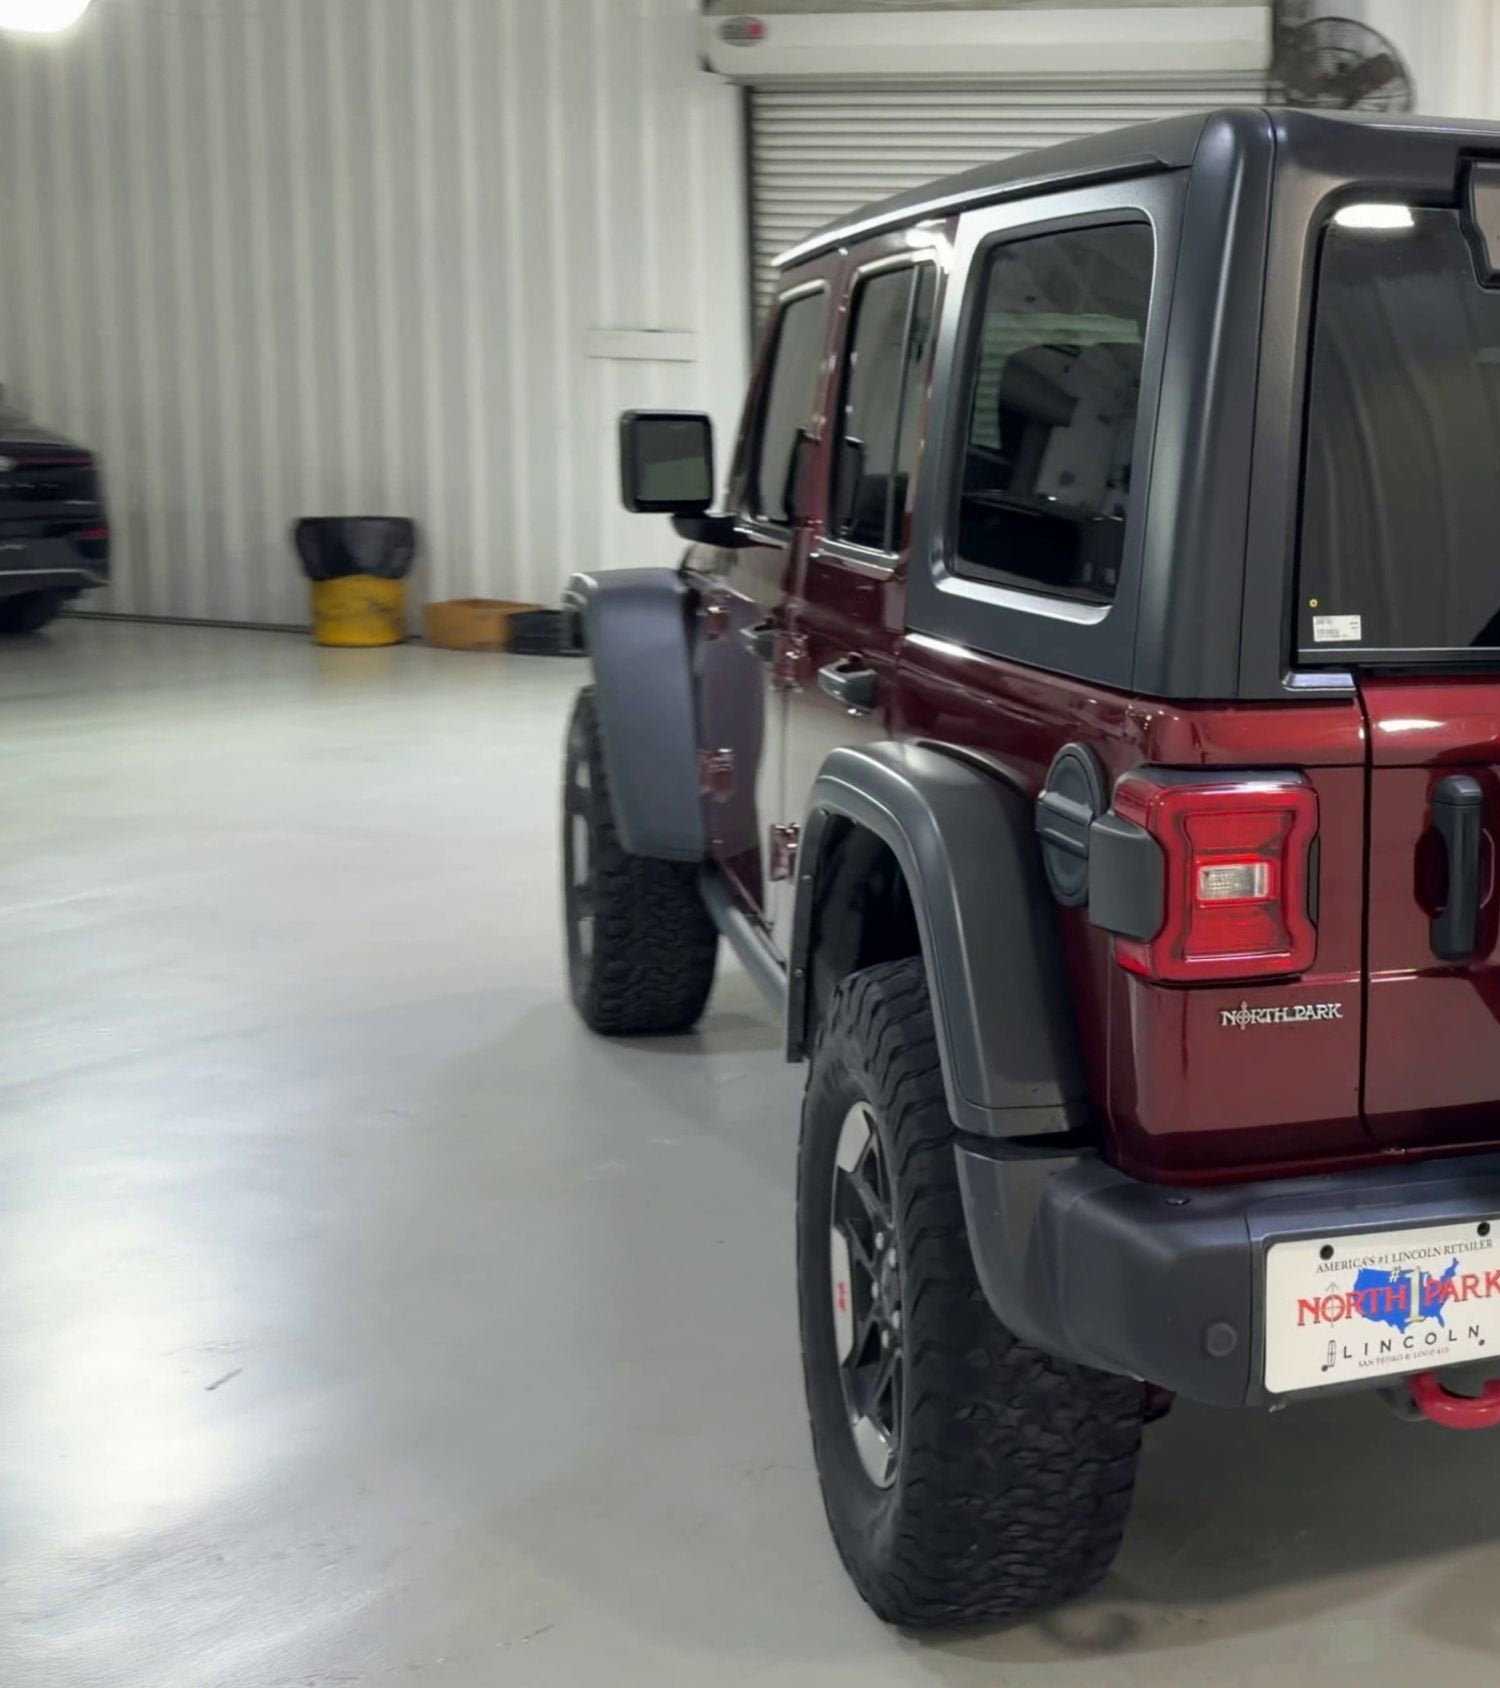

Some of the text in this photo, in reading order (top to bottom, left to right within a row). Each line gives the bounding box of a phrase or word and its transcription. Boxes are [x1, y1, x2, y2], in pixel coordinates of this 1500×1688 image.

[1292, 1002, 1343, 1020] PARK
[1316, 1238, 1494, 1274] AMERICA'S #1 LINCOLN RETAILER
[1297, 1284, 1407, 1327] NORTH
[1343, 1324, 1480, 1360] LINCOLN
